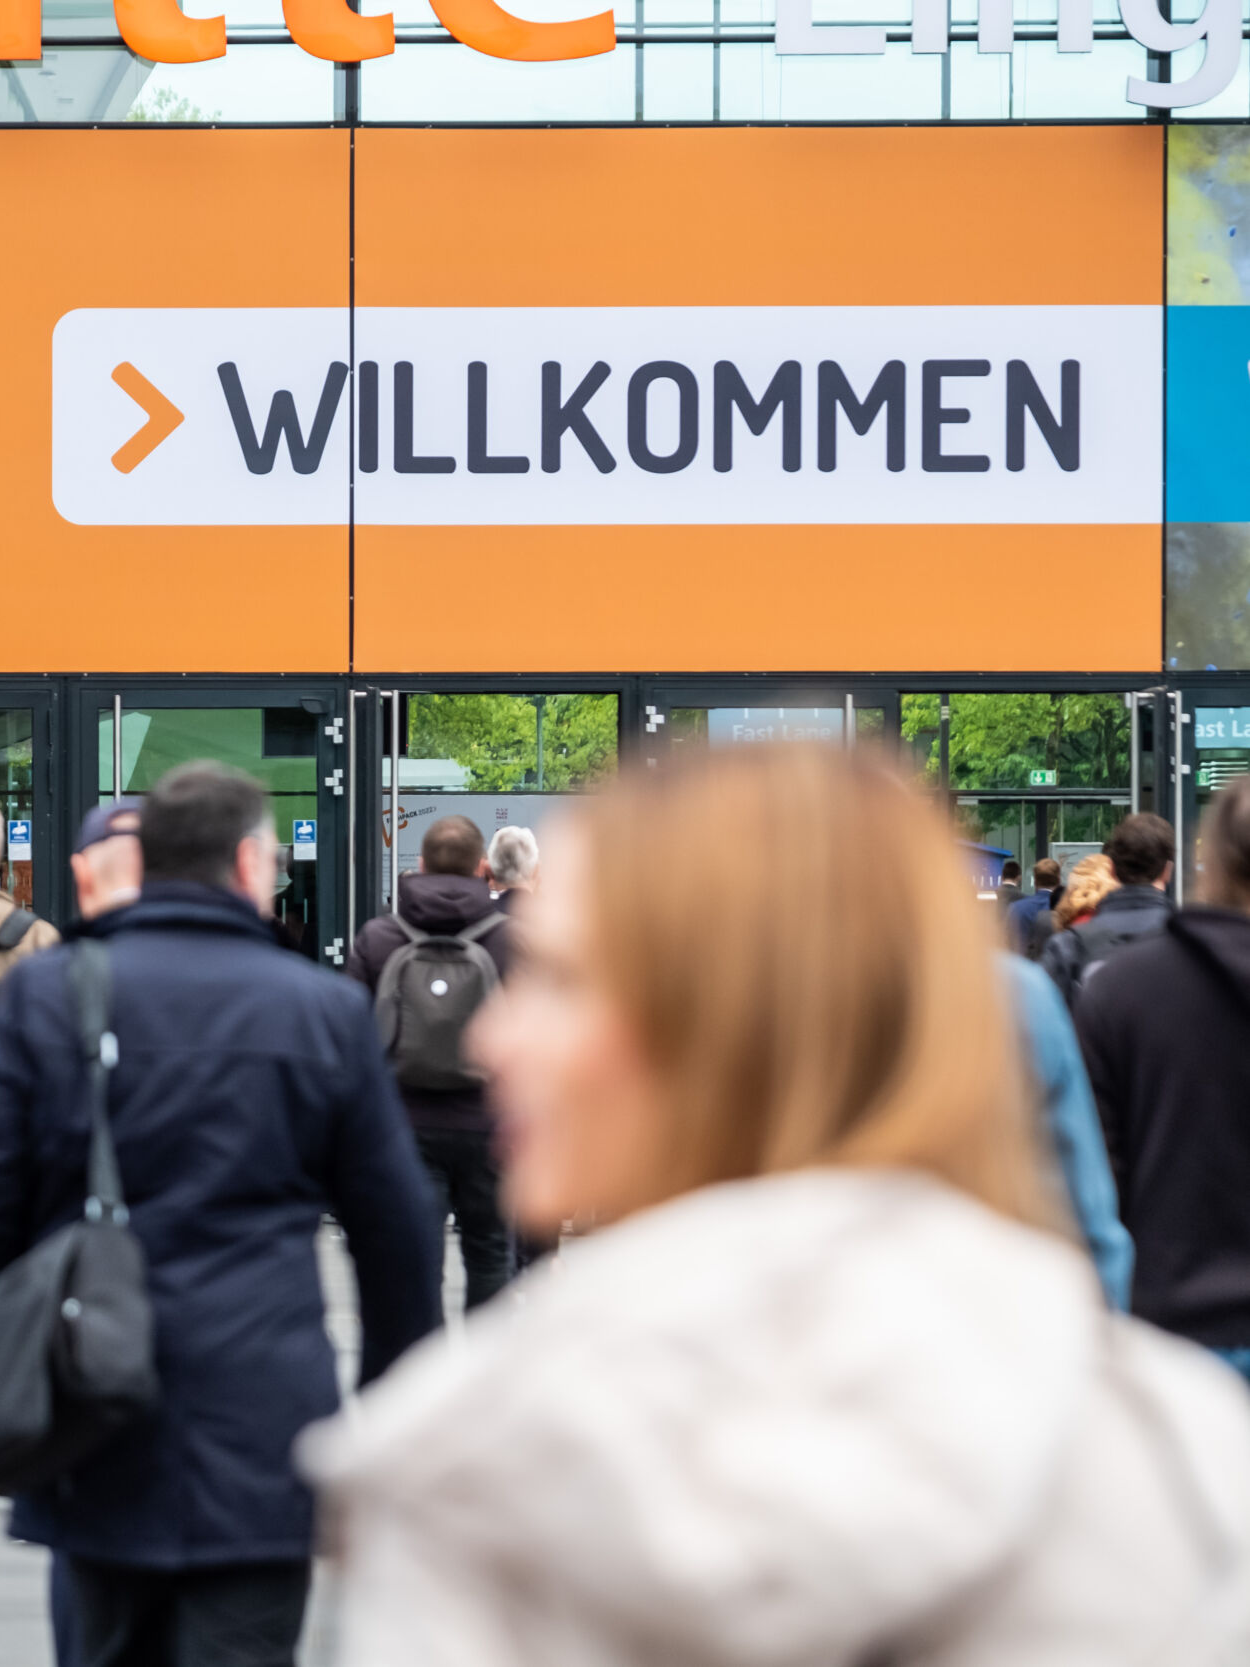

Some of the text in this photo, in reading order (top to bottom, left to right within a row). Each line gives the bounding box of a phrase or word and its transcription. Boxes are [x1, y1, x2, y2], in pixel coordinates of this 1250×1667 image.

[216, 358, 1081, 476] WILLKOMMEN
[732, 724, 833, 742] Fast Lane
[1195, 721, 1225, 738] ast
